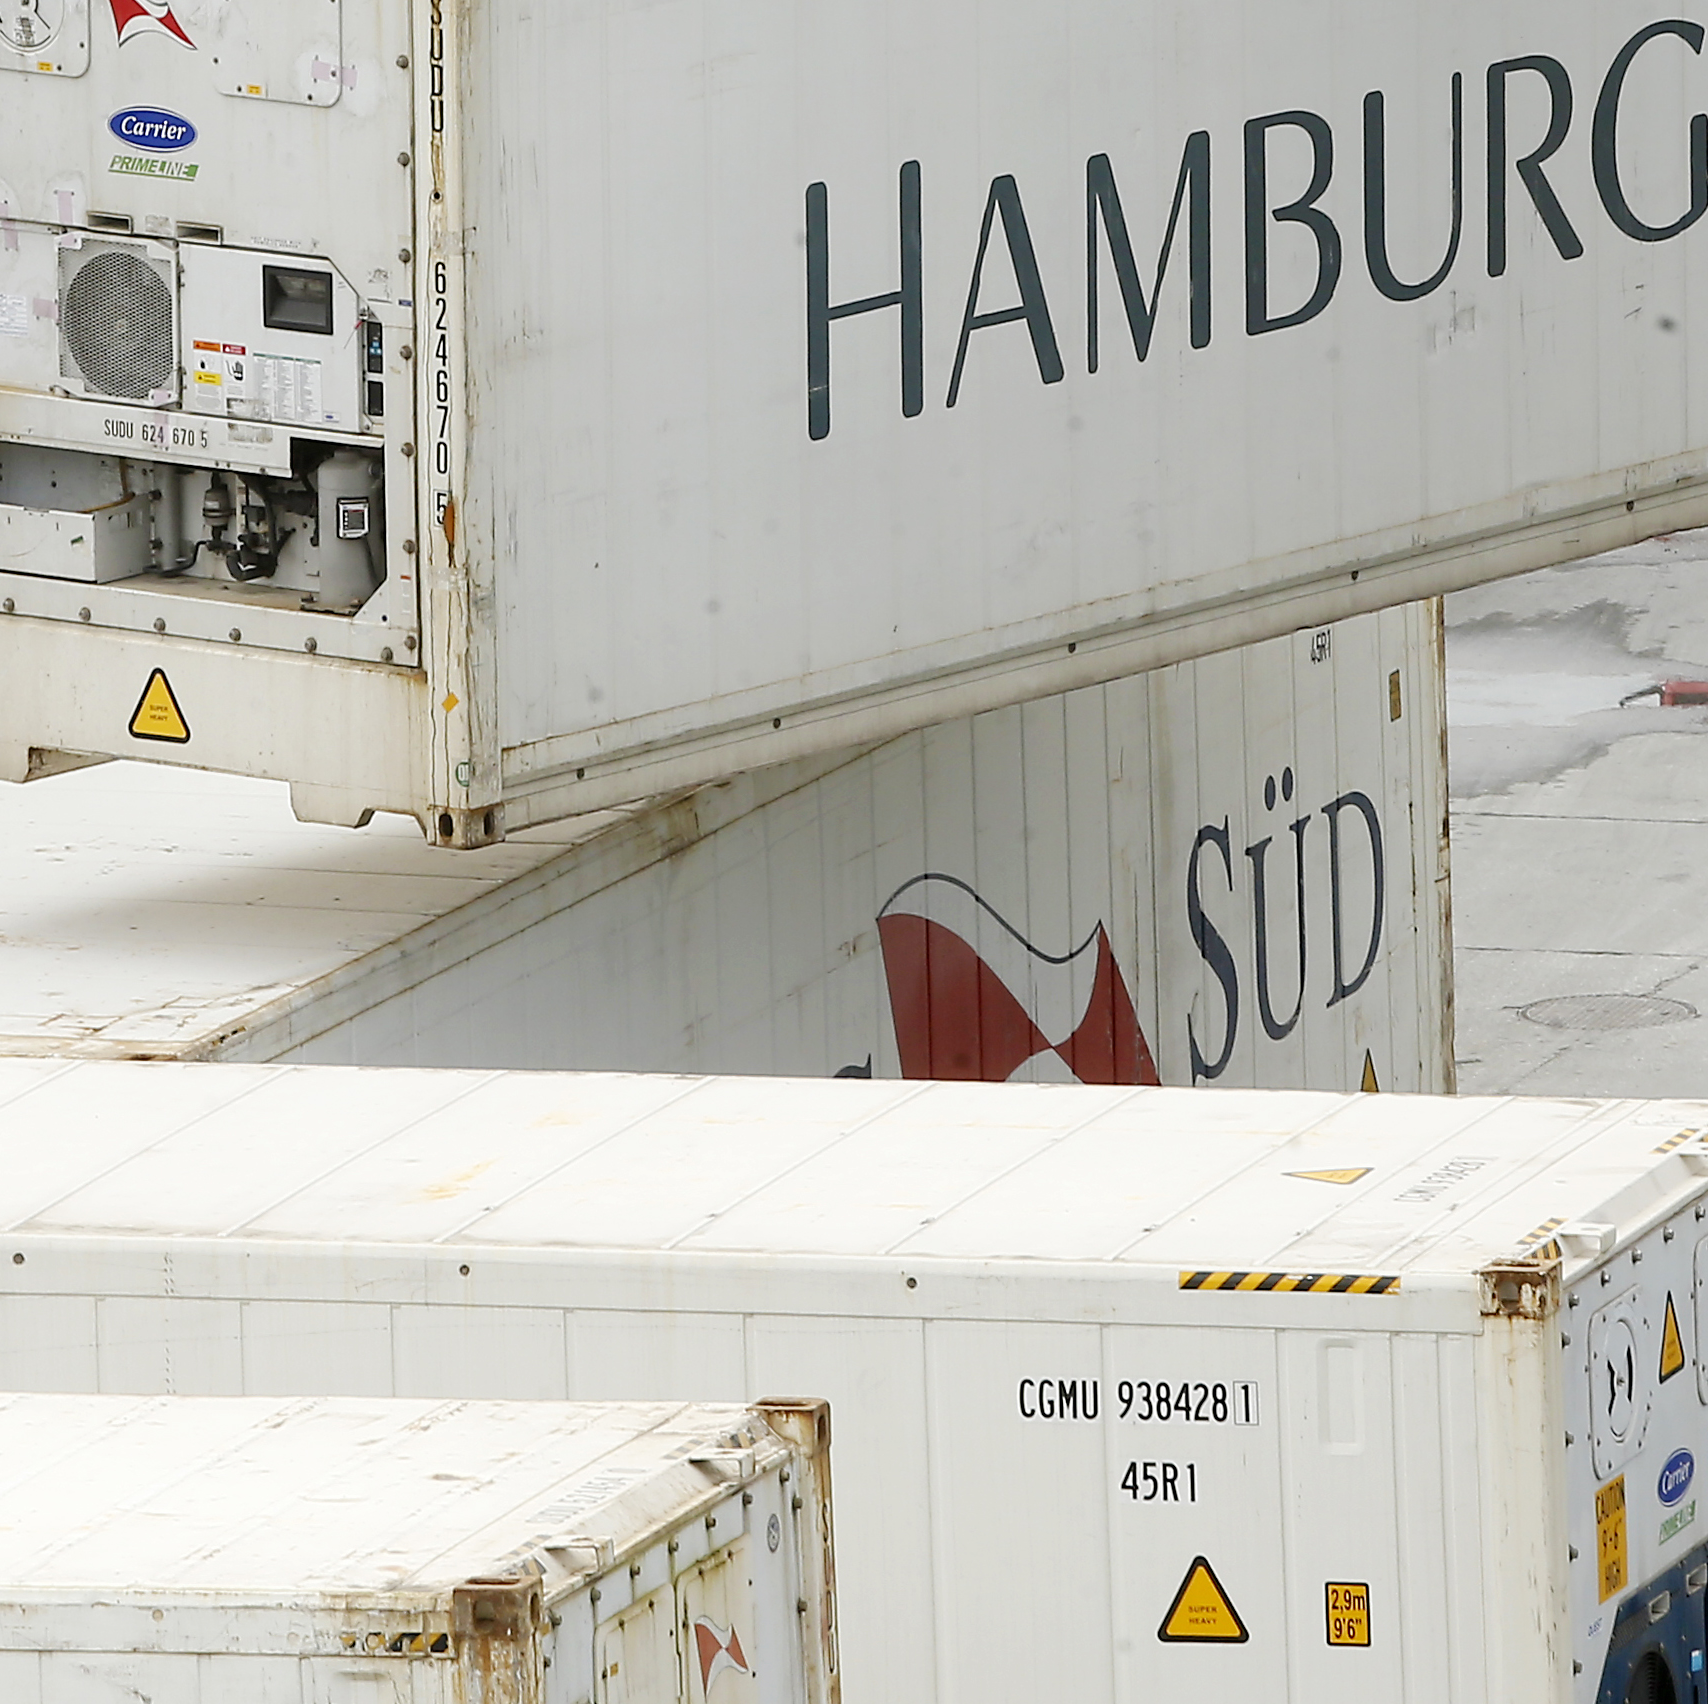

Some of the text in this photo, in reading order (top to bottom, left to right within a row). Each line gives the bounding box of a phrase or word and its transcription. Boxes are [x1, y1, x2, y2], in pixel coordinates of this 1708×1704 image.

[121, 115, 187, 140] Carrier
[104, 419, 133, 438] SUDU
[142, 425, 165, 443] 624
[172, 427, 195, 447] 670
[1186, 765, 1385, 1087] SÜD
[1018, 1378, 1251, 1423] CGMU 938428 1
[1121, 1461, 1197, 1502] 45R1
[1661, 1461, 1691, 1495] Carrier
[1188, 1605, 1218, 1614] SUPER
[1188, 1616, 1218, 1626] HEAVY
